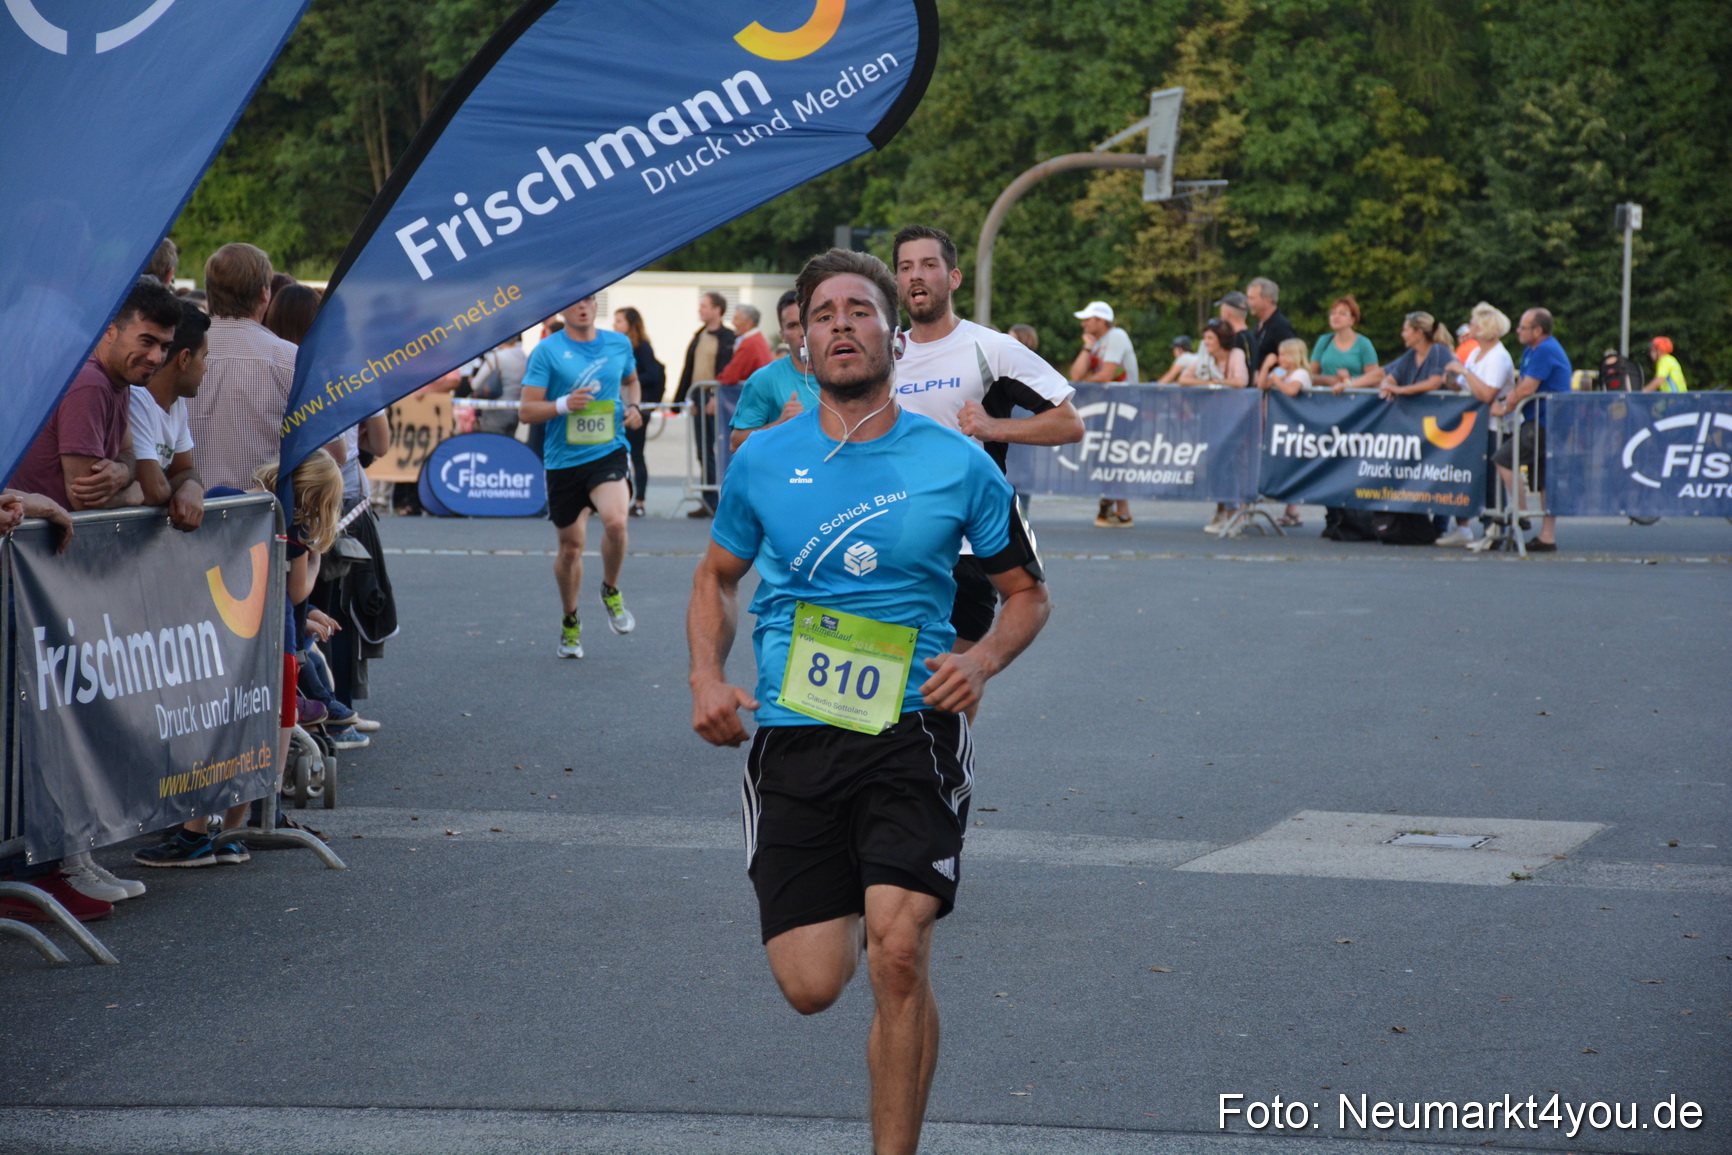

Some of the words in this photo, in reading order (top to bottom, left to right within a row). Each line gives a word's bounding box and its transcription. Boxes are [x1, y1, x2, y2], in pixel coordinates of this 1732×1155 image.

[640, 135, 731, 195] Druck
[733, 107, 793, 147] und
[791, 50, 899, 123] Medien
[395, 70, 773, 281] Frischmann
[576, 418, 606, 433] 806
[1270, 423, 1422, 461] Frischmann
[1080, 431, 1208, 466] Fischer
[1661, 444, 1732, 479] Fis
[459, 467, 534, 489] Fischer
[1091, 467, 1194, 485] AUTOMOBILE
[1358, 459, 1392, 479] Druck
[1394, 463, 1422, 480] und
[1421, 464, 1473, 484] Medien
[468, 489, 531, 499] AUTOMOBILE
[1355, 487, 1471, 507] www.frischmann-net.de
[789, 535, 820, 573] Team
[819, 502, 872, 535] Schick
[873, 490, 907, 507] Bau
[33, 613, 224, 711] Frischmann
[807, 652, 881, 701] 810
[155, 695, 198, 740] Druck
[201, 687, 230, 730] und
[806, 692, 833, 707] Claudio
[832, 701, 869, 717] Sottolano
